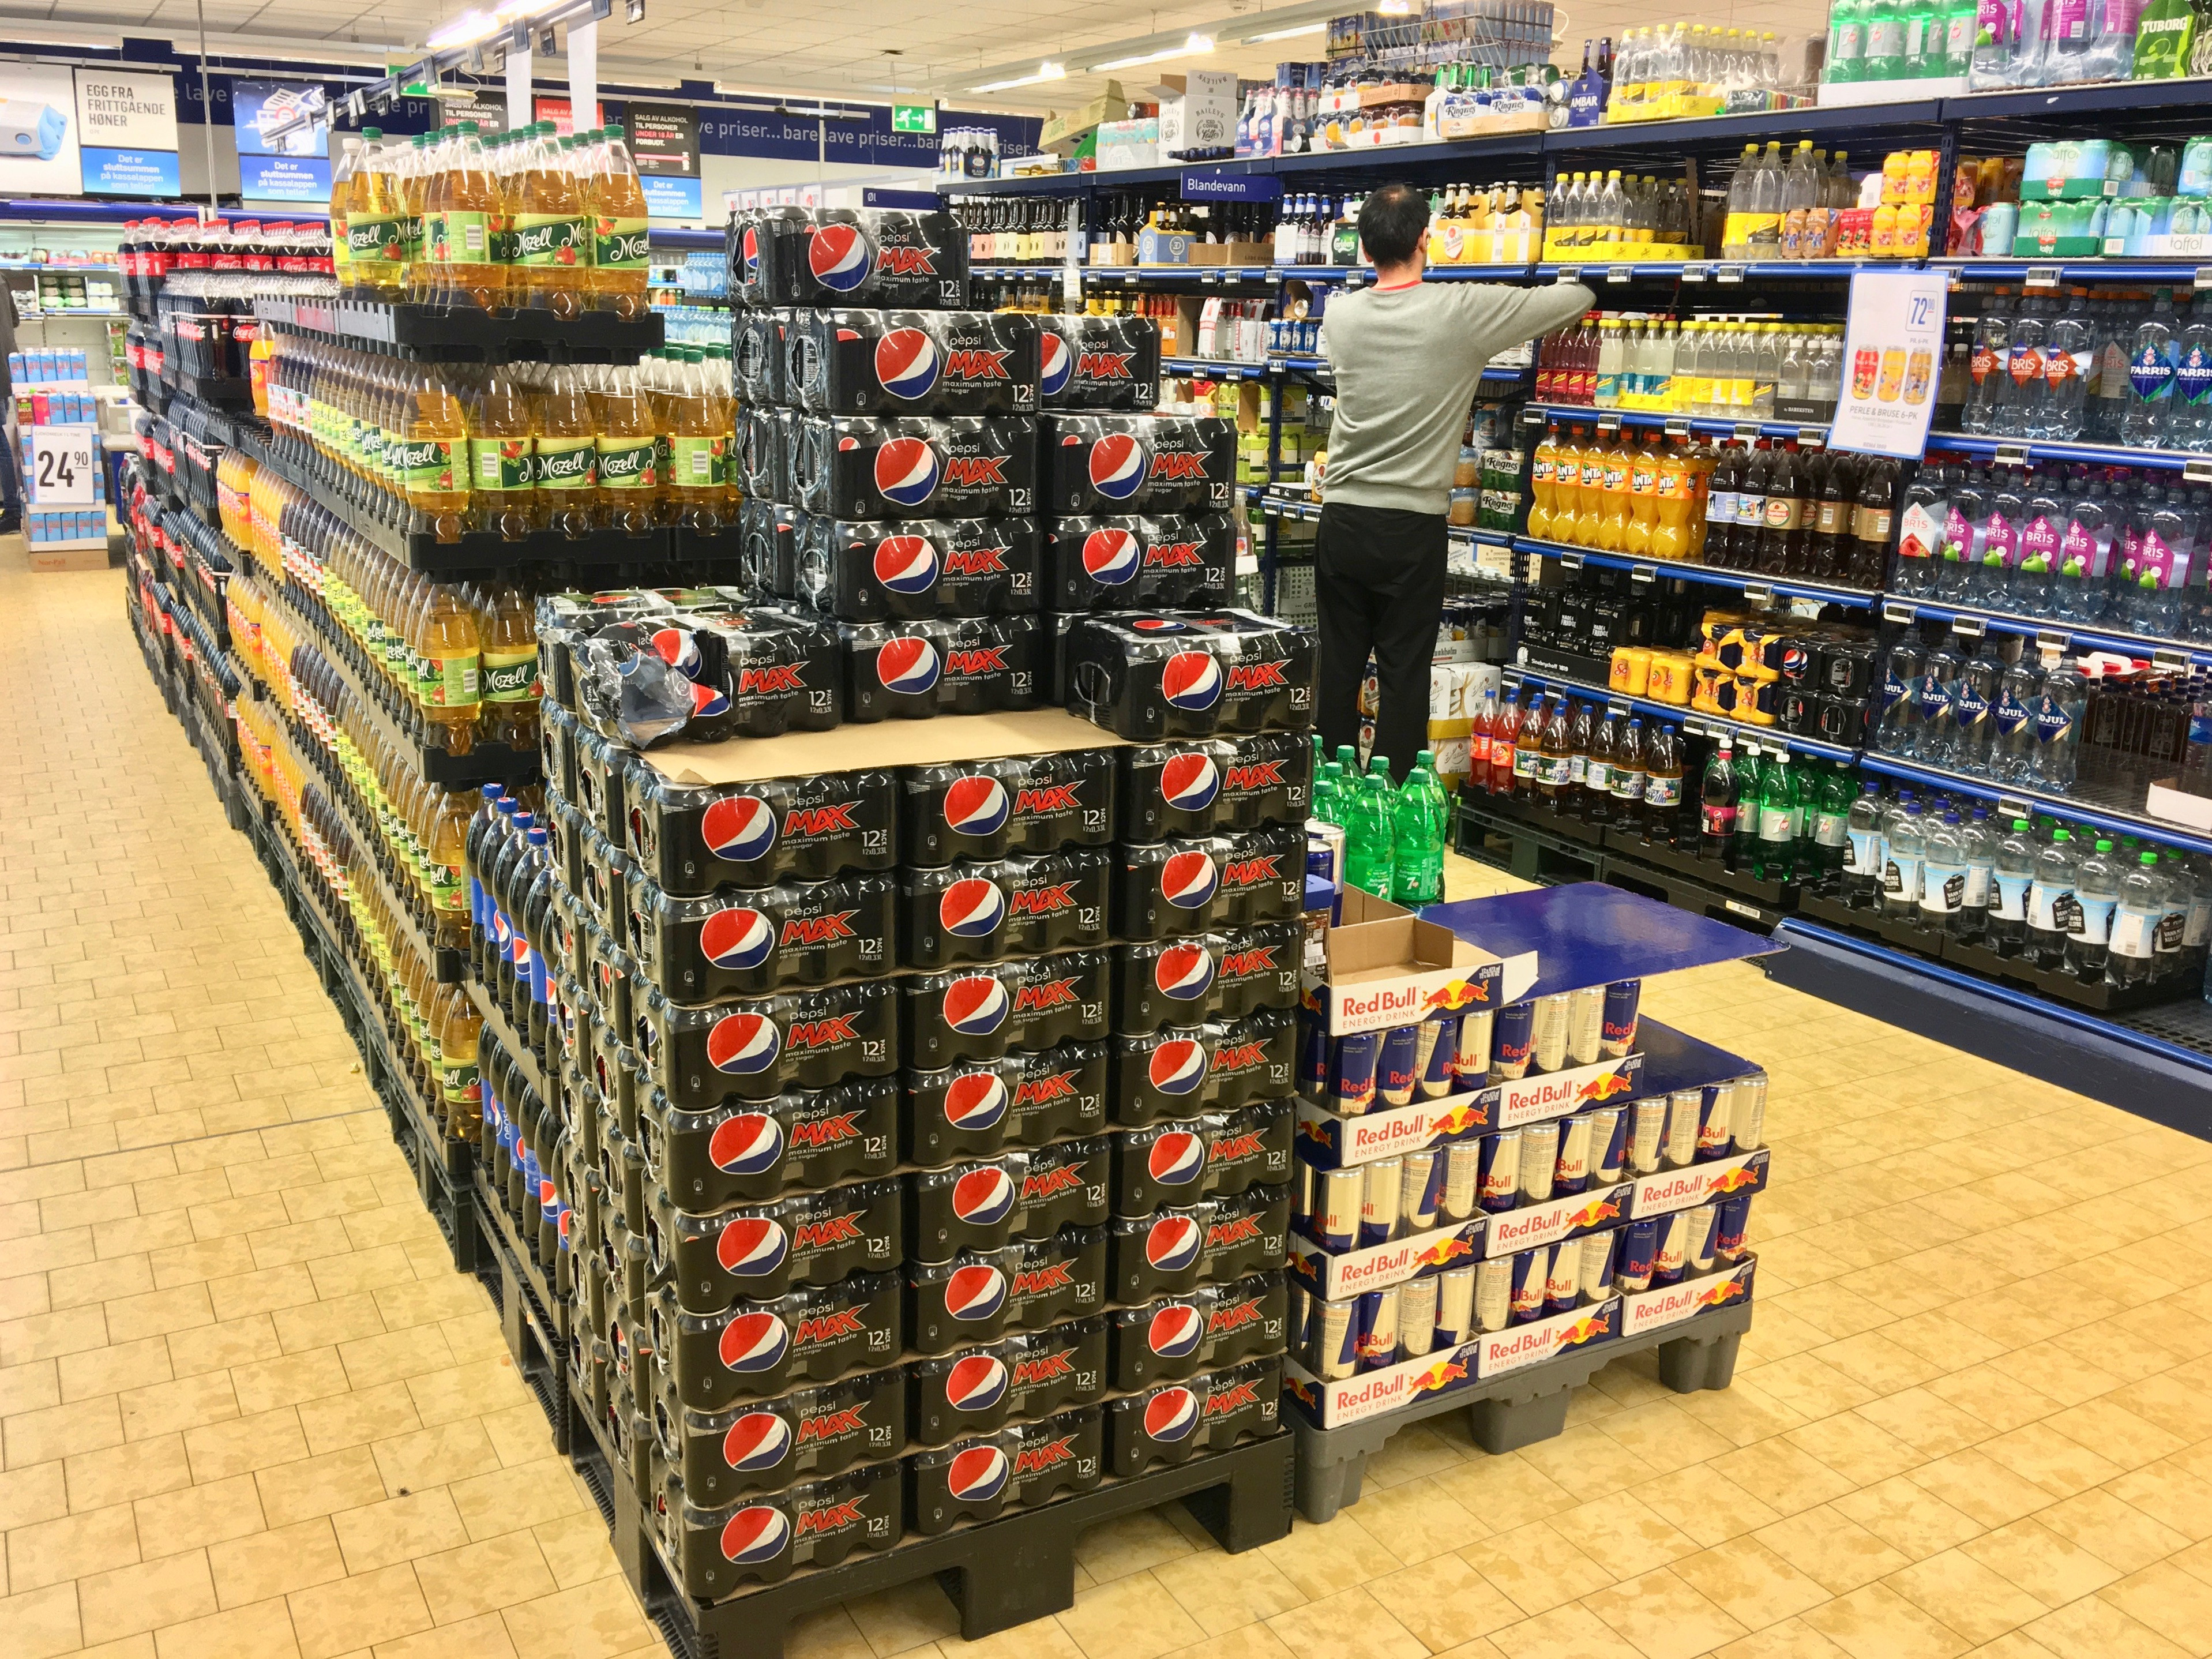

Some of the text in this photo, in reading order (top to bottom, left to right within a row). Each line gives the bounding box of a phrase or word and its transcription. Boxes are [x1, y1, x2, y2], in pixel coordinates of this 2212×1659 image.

[2140, 16, 2188, 34] TUBORG
[1197, 73, 1229, 85] BAILEYS
[87, 84, 134, 99] EGG FRA
[88, 99, 166, 115] FRITTGÅENDE
[472, 102, 504, 111] ALKOHOL
[1492, 99, 1524, 112] Ringnes
[1570, 95, 1598, 108] AMBAR
[445, 110, 493, 119] TIL PERSONER
[661, 115, 688, 123] ALKOHOL
[1196, 108, 1226, 119] BAILEYS
[1445, 105, 1476, 119] Ringnes
[89, 112, 128, 127] HØNER
[645, 122, 678, 131] PERSONER
[666, 130, 675, 139] ÅR
[783, 124, 818, 142] bare
[917, 133, 942, 150] bar
[998, 139, 1041, 157] riser...
[636, 138, 666, 147] FORBUDT.
[118, 154, 133, 163] Det
[103, 164, 160, 174] sluttsummen
[274, 162, 289, 170] Det
[100, 172, 164, 183] på kassalappen
[260, 170, 314, 180] sluttsummen
[258, 178, 317, 189] på kassalappen
[654, 181, 666, 189] Det
[1187, 178, 1246, 193] Blandevann
[645, 189, 686, 198] luttsummen
[867, 192, 877, 202] Øl
[648, 197, 689, 206] kassalappen
[512, 226, 555, 257] Mozell
[880, 232, 910, 245] pepsi
[1332, 236, 1355, 254] Carlsberg
[2169, 236, 2203, 253] taffel
[873, 246, 941, 275] MAX
[873, 275, 911, 283] maximum
[882, 281, 899, 290] sugar
[938, 280, 956, 298] 12
[1910, 297, 1936, 325] 72 00
[949, 335, 981, 348] pepsi
[942, 349, 1016, 380] MAX
[1971, 355, 1991, 368] BRIS
[2011, 358, 2036, 371] BRIS
[2046, 358, 2070, 372] BRIS
[2130, 365, 2172, 376] FARRIS
[1012, 384, 1030, 403] 12
[1787, 406, 1815, 414] BAREKSTEN
[1850, 405, 1918, 420] PERLE & BRUSE 6-PK
[1155, 438, 1184, 451] pepsi
[37, 450, 89, 487] 24 90
[536, 449, 585, 480] Mozell
[1148, 451, 1214, 481] MAX
[1486, 456, 1518, 471] Ringnes
[1482, 496, 1513, 511] Ringnes
[1903, 518, 1928, 529] BRIS
[1986, 526, 2009, 539] BRIS
[2026, 531, 2055, 544] BRIS
[2066, 534, 2088, 548] BRIS
[1560, 619, 1577, 628] FRIDGE
[1592, 628, 1609, 637] FRIDGE
[483, 667, 529, 697] Mozell
[787, 792, 825, 809] pepsi
[781, 799, 865, 838] MAX
[782, 831, 851, 846] maximum taste
[861, 830, 881, 848] 12
[792, 843, 813, 851] sugar
[1343, 986, 1417, 1017] Red Bull
[1342, 1009, 1415, 1029] ENERGY DRINK
[1508, 1079, 1572, 1110] Red Bull
[1507, 1101, 1570, 1121] ENERGY DRINK
[1642, 1174, 1703, 1204] Red Bull
[1640, 1193, 1700, 1213] ENERGY DRINK
[1337, 1373, 1404, 1410] Red Bull
[800, 1400, 836, 1418] pepsi
[1336, 1394, 1403, 1421] ENERGY DRINK
[795, 1400, 872, 1446] MAX
